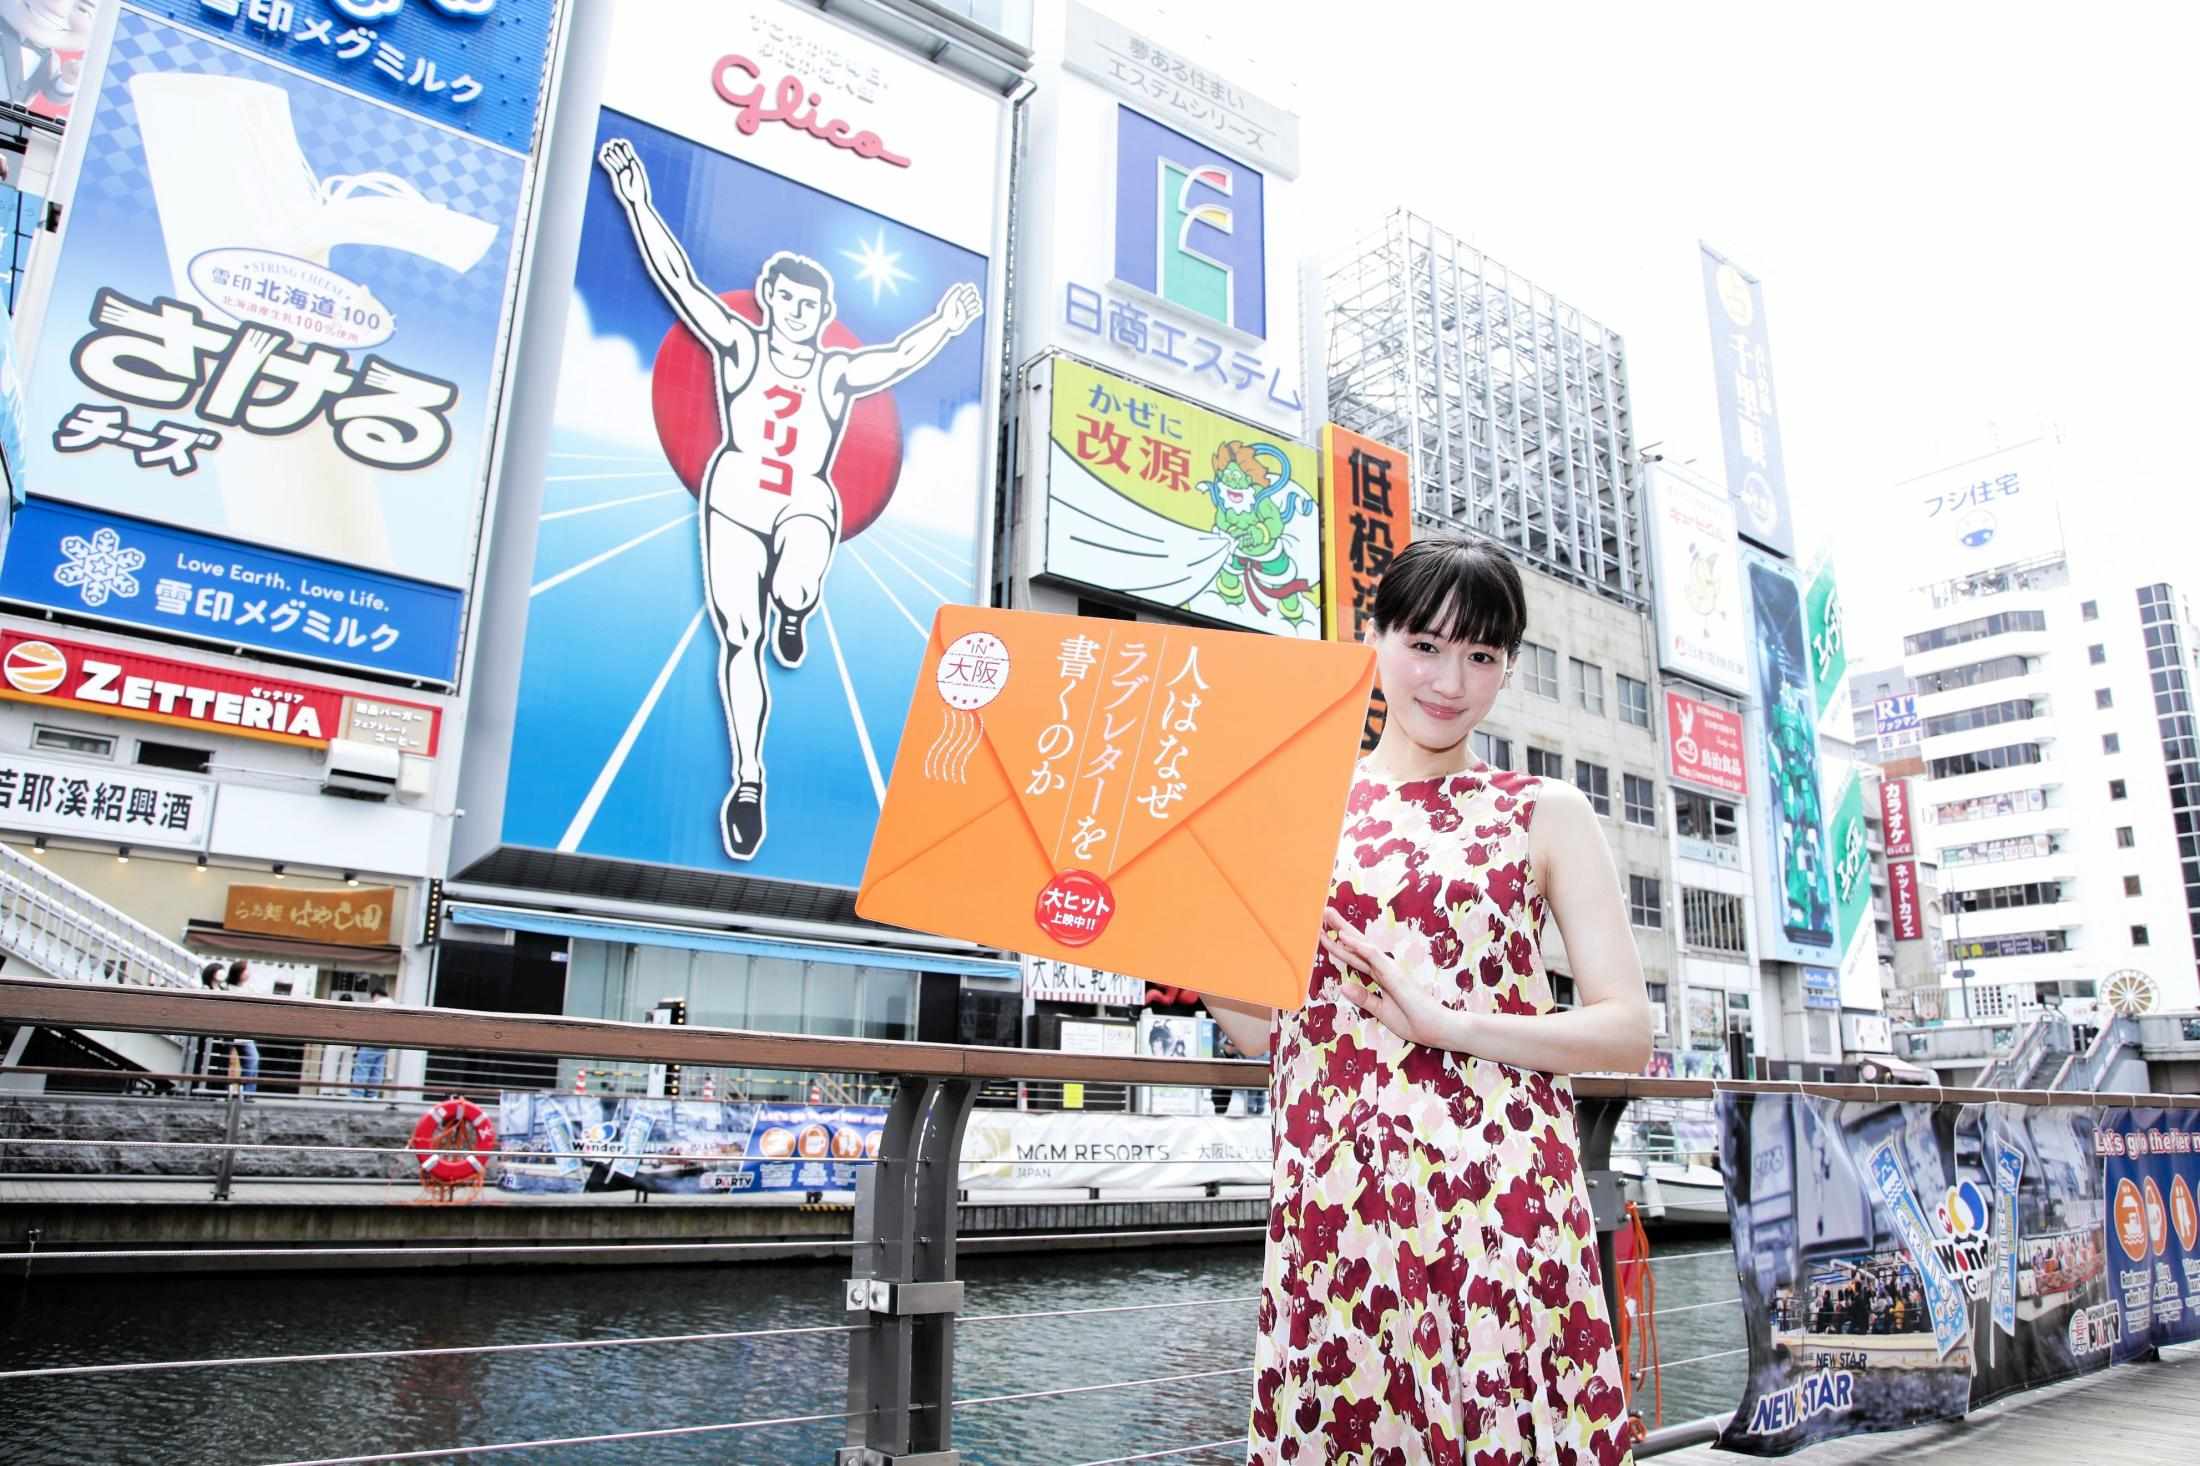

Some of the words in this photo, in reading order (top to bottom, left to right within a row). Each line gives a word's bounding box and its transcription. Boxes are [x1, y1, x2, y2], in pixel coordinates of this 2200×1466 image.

[1109, 58, 1266, 152] エステムシリーズ
[1066, 282, 1303, 411] 日商エステム
[72, 289, 457, 468] さける
[54, 404, 220, 475] チーズ
[758, 384, 807, 496] グリコ
[1088, 382, 1184, 440] かぜに
[1076, 413, 1192, 493] 改源
[177, 552, 225, 578] Love
[230, 563, 292, 592] Earth.
[301, 578, 345, 601] Love
[349, 589, 391, 613] Life.
[154, 577, 400, 654] 雪印メグミルク
[944, 658, 999, 686] 大阪
[970, 643, 988, 656] IN
[76, 659, 323, 739] ZETTERIA
[251, 687, 304, 703] ゼッテリア
[1024, 634, 1099, 795] 書くのか
[375, 732, 420, 746] コーヒー
[1071, 641, 1150, 861] ラブレターを
[1137, 645, 1211, 819] 人はなぜ
[1885, 783, 1904, 844] カラオケ
[1044, 887, 1112, 915] 大ヒット
[1895, 864, 1915, 937] ネットカフェ
[572, 1141, 624, 1152] Wonder
[1016, 1144, 1068, 1161] MGM
[1075, 1144, 1170, 1161] RESORTS
[1016, 1166, 1052, 1180] JAPAN
[715, 1177, 751, 1188] PARTY
[1840, 1352, 1867, 1368] STAR
[1751, 1384, 1798, 1432] NEW
[1800, 1372, 1852, 1418] STAR
